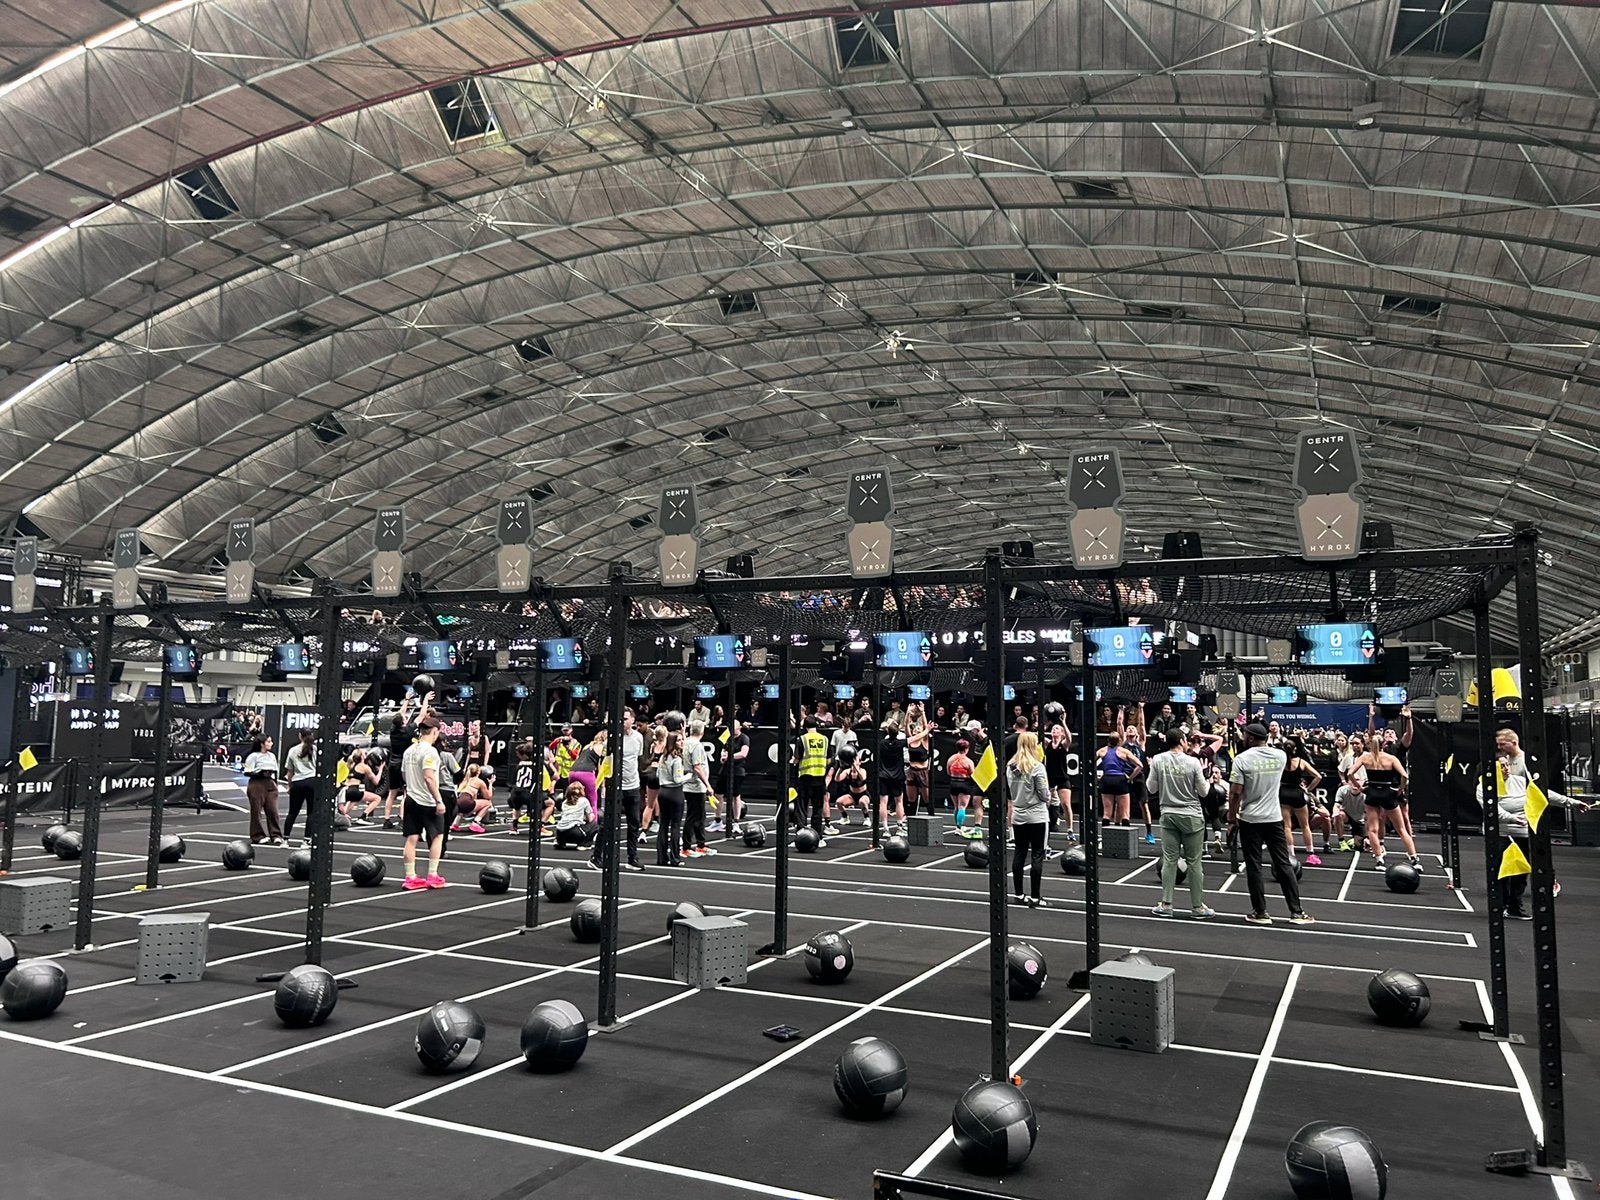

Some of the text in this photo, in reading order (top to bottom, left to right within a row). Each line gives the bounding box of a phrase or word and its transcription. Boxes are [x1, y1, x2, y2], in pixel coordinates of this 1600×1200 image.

[1307, 435, 1344, 445] CENTR
[1077, 454, 1110, 463] CENTR
[855, 472, 882, 482] CENTR
[665, 488, 689, 497] CENTR
[1310, 543, 1351, 552] HYROX
[1079, 554, 1115, 562] HYROX
[856, 563, 886, 572] HYROX
[1113, 634, 1125, 649] 0
[1330, 631, 1342, 648] 0
[715, 641, 724, 654] 0
[897, 638, 907, 652] 0
[71, 708, 120, 719] HYOX
[111, 775, 186, 790] MYPROEIN
